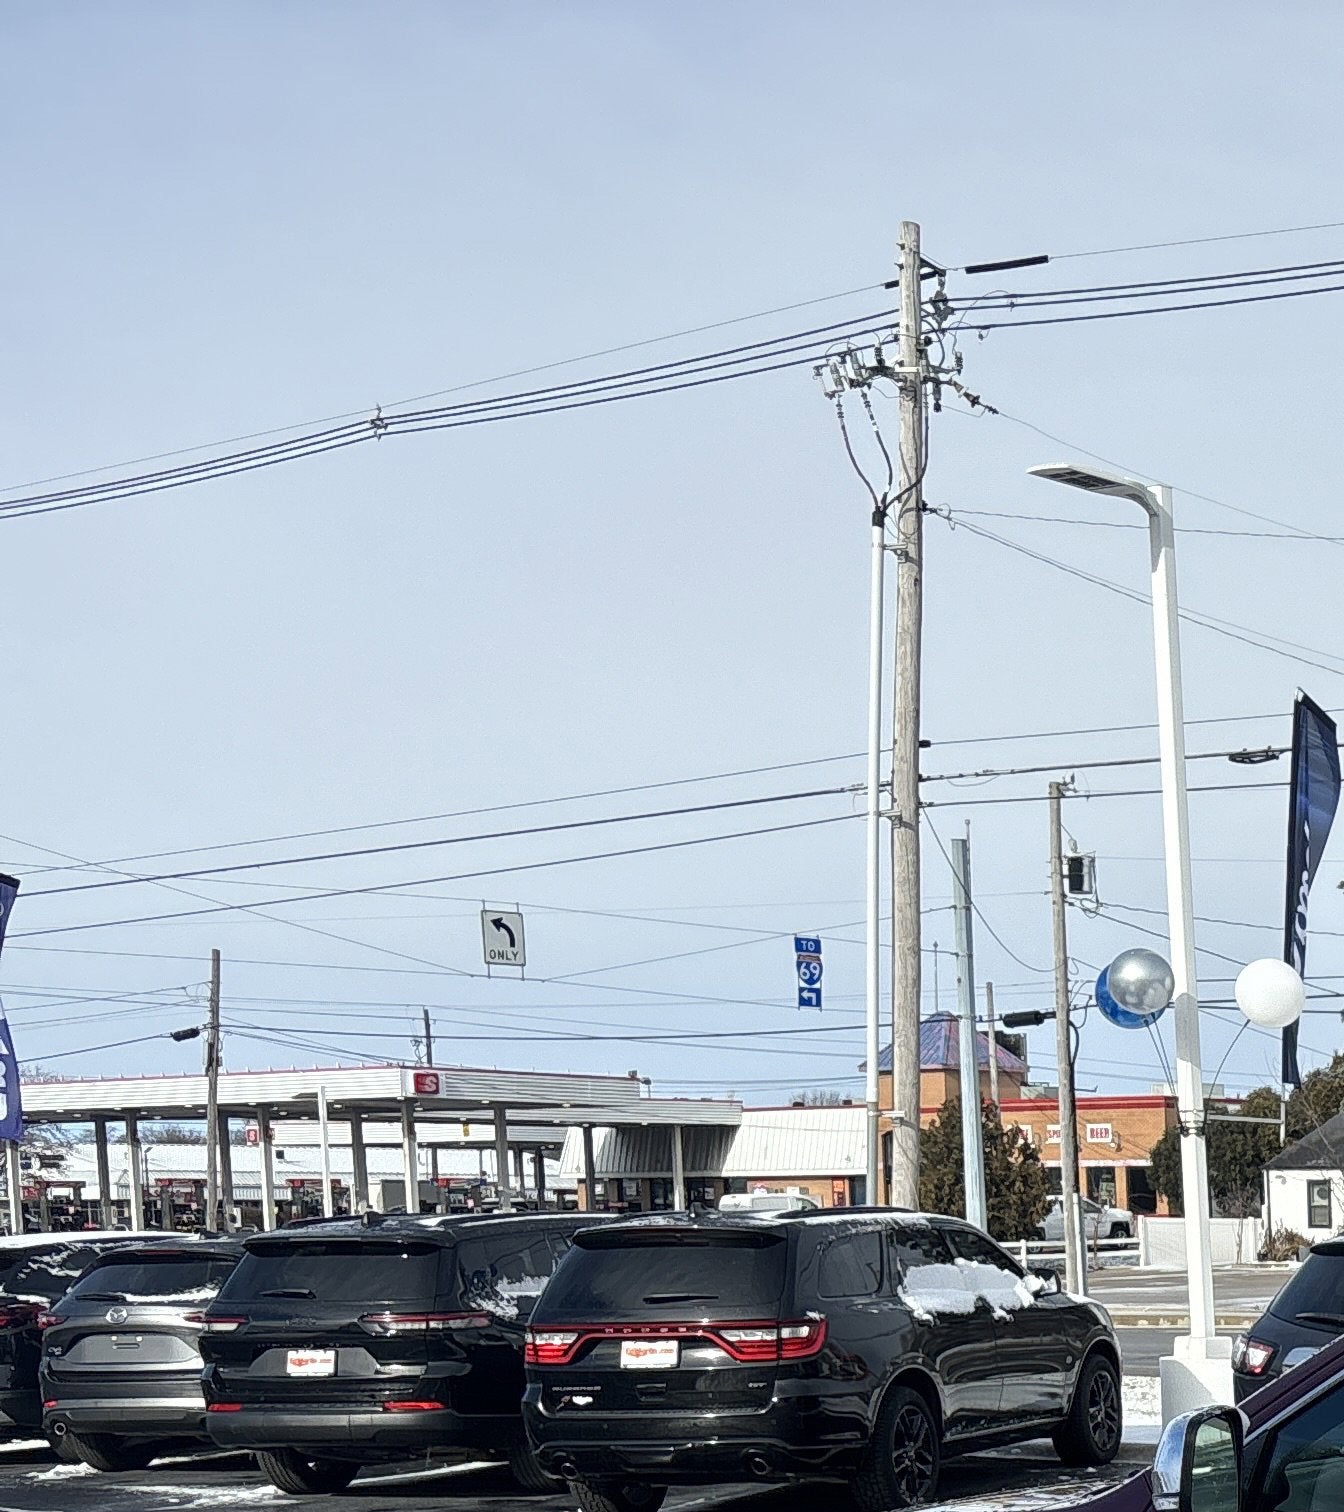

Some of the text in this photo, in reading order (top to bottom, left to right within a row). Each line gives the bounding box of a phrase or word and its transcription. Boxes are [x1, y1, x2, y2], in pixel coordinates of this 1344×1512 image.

[801, 941, 815, 951] TO
[489, 949, 519, 961] ONLY
[800, 962, 820, 980] 69
